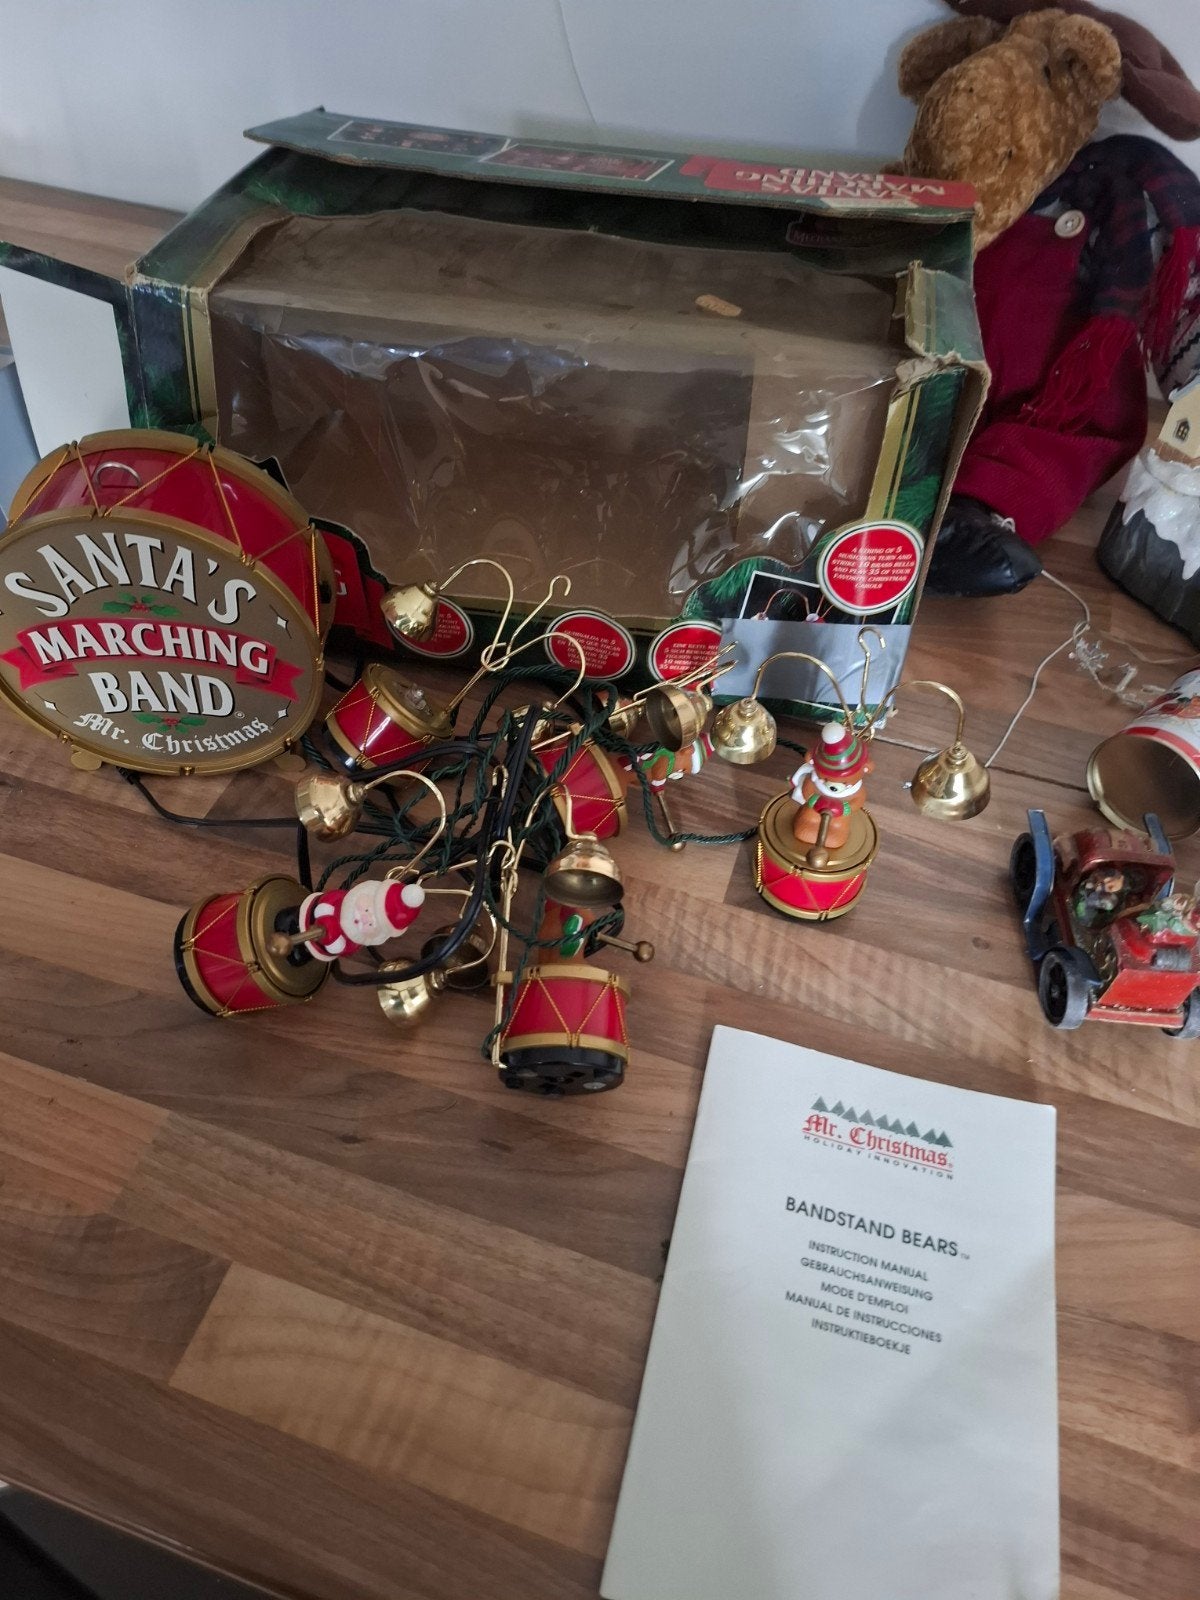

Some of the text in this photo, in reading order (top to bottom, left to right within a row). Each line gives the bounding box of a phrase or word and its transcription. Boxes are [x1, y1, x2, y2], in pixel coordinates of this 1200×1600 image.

[4, 532, 257, 625] SANTA'S
[27, 622, 269, 674] MARCHING
[88, 670, 235, 717] BAND
[73, 712, 272, 755] Mr. Christmas
[803, 1113, 953, 1168] Mr. Christmas
[803, 1135, 954, 1180] HOLIDAY INNOVATION
[785, 1196, 896, 1239] BANDSTAND
[800, 1256, 934, 1302] GEBRAUCHSANWEISUNG
[808, 1239, 928, 1281] INSTRUCTION MANUAL
[784, 1290, 943, 1343] MANUAL DE INSTRUCCIONES
[820, 1281, 909, 1314] MODE D'EMPLOI
[811, 1317, 912, 1355] INSTRUKTIEBOEKJE
